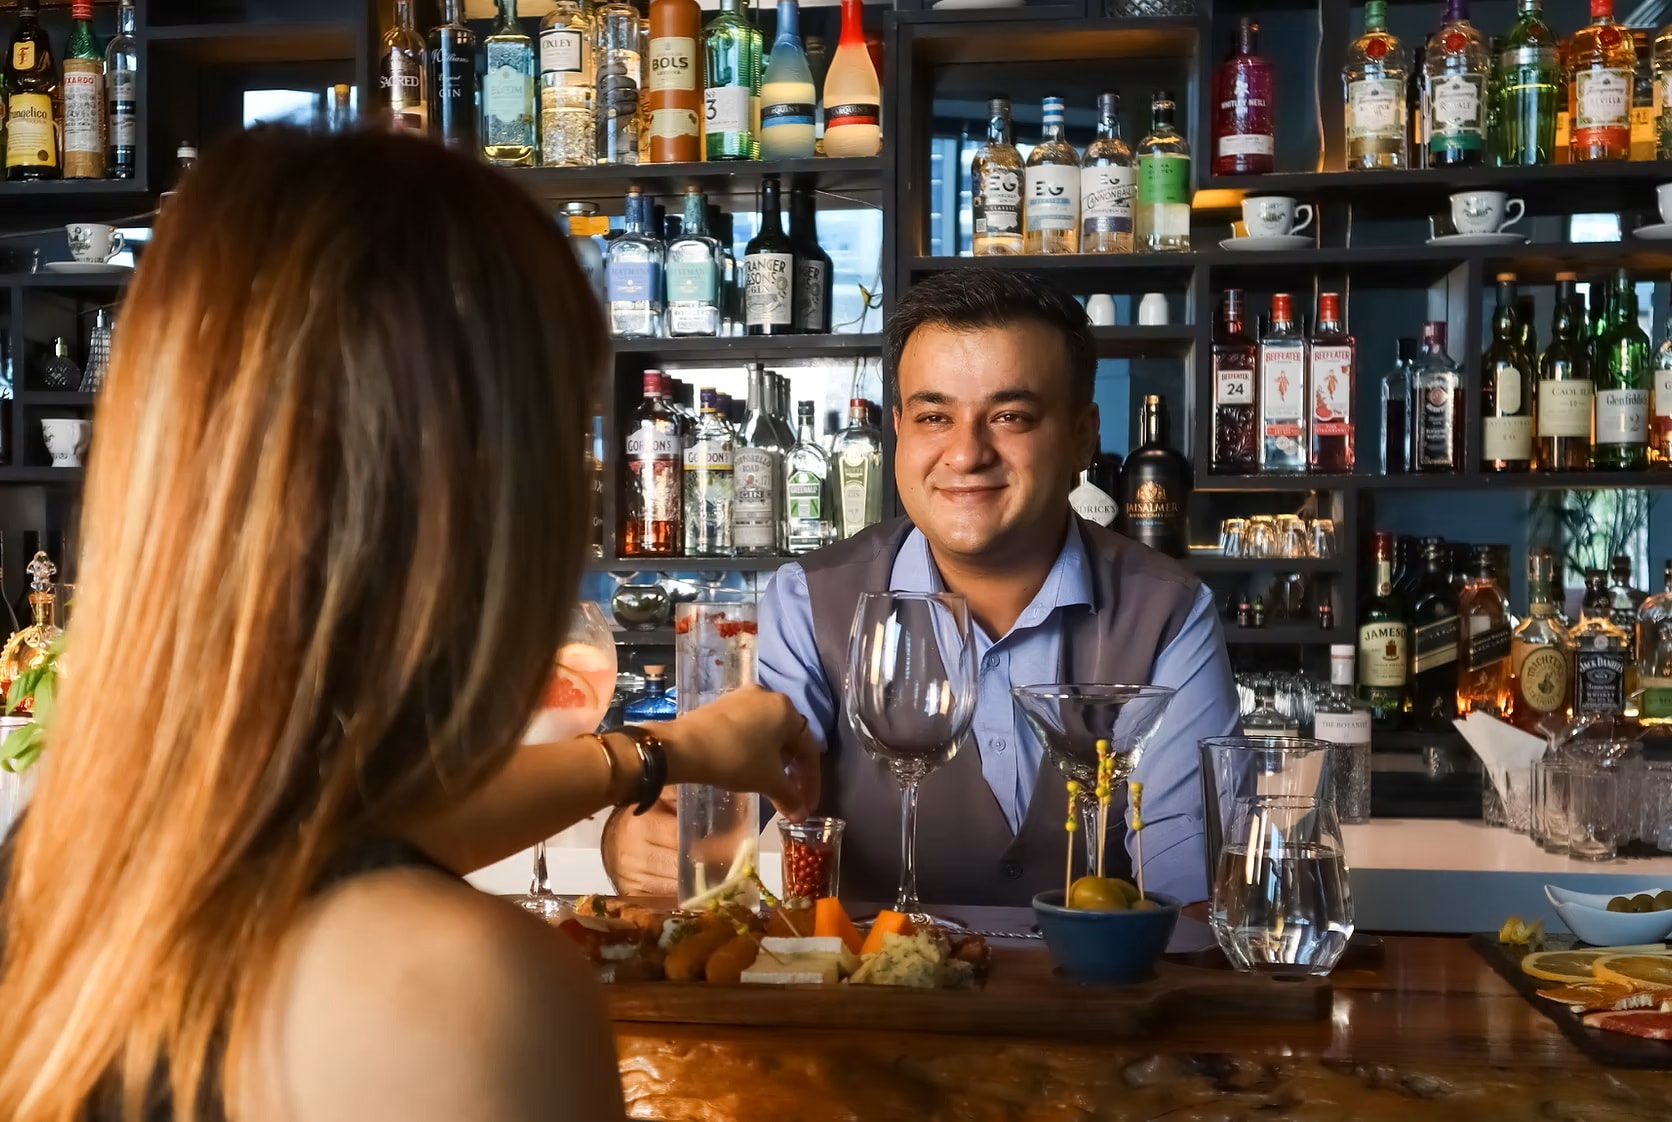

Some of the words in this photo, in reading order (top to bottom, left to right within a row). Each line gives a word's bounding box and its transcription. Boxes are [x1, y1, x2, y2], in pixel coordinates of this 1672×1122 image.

[652, 57, 689, 71] BOLS
[64, 77, 95, 85] XARDO
[438, 88, 461, 98] GIN
[706, 99, 717, 120] 3
[745, 259, 786, 274] RANGER
[1265, 351, 1301, 362] BEEFEATER
[1314, 351, 1350, 361] BEEFEATER
[1221, 373, 1250, 381] BEEFEATER
[1227, 383, 1244, 396] 24
[627, 440, 672, 452] GORON'S
[688, 452, 729, 463] GODON'S
[1126, 502, 1179, 514] JAISALMER
[1364, 627, 1406, 642] JAMESO
